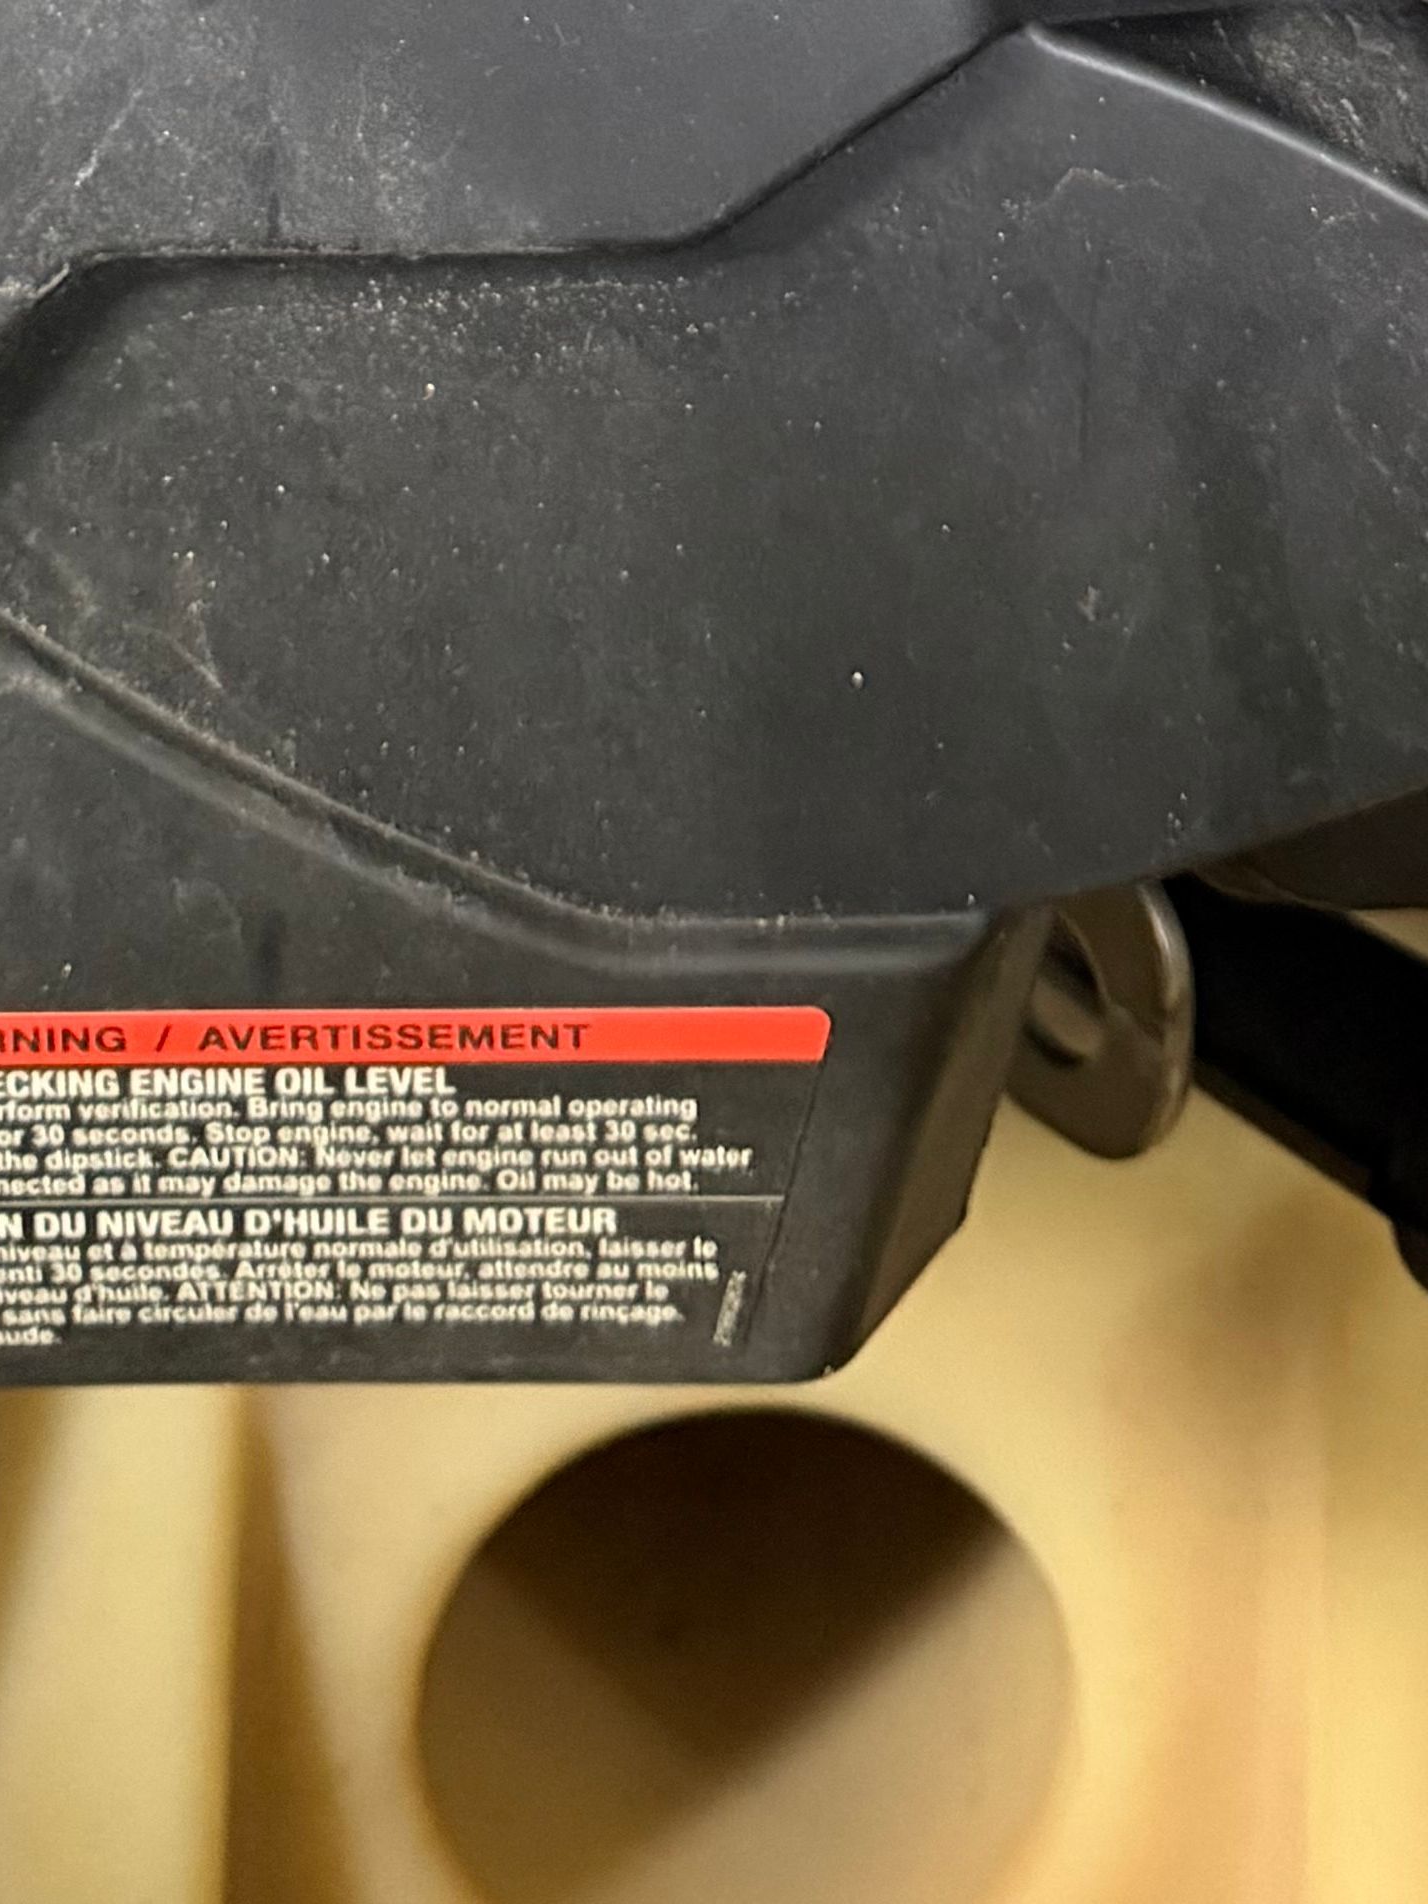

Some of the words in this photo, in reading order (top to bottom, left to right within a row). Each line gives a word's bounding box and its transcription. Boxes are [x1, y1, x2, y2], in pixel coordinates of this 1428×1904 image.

[155, 1024, 172, 1053] /
[197, 1022, 591, 1052] AVERTISSEMENT
[130, 1068, 266, 1096] ENGINE
[274, 1067, 334, 1095] OIL
[344, 1065, 457, 1094] LEVEL
[78, 1096, 240, 1120] verification.
[247, 1096, 323, 1123] Bring
[329, 1096, 423, 1122] engine
[430, 1097, 459, 1117] to
[465, 1094, 561, 1116] normal
[568, 1094, 698, 1123] operating
[31, 1124, 65, 1146] 30
[203, 1121, 272, 1147] Stop
[386, 1121, 443, 1143] wait
[450, 1121, 490, 1142] for
[497, 1122, 524, 1142] at
[530, 1120, 598, 1142] least
[604, 1120, 636, 1142] 30
[44, 1148, 163, 1173] dipstick.
[168, 1146, 308, 1169] CAUTION:
[315, 1146, 396, 1169] Never
[401, 1146, 436, 1167] let
[442, 1145, 534, 1172] engine
[540, 1148, 587, 1167] run
[593, 1146, 638, 1167] out
[644, 1144, 673, 1166] of
[92, 1176, 125, 1194] as
[132, 1173, 152, 1193] it
[157, 1175, 217, 1199] may
[222, 1172, 332, 1197] damage
[338, 1171, 383, 1192] the
[495, 1169, 536, 1191] Oil
[542, 1172, 599, 1196] may
[606, 1171, 640, 1191] be
[647, 1170, 699, 1192] hot.
[33, 1211, 87, 1240] DU
[95, 1210, 234, 1239] NIVEAU
[243, 1208, 391, 1237] D'HUILE
[400, 1208, 453, 1235] DU
[463, 1207, 618, 1235] MOTEUR
[86, 1243, 115, 1262] et
[120, 1242, 138, 1261] à
[143, 1240, 307, 1263] température
[312, 1239, 422, 1259] normale
[598, 1238, 686, 1259] laisser
[693, 1235, 718, 1258] le
[49, 1263, 83, 1283] 30
[234, 1260, 330, 1281] Arrêter
[336, 1259, 363, 1279] le
[477, 1260, 589, 1280] attendre
[596, 1262, 630, 1279] au
[637, 1260, 720, 1281] moins
[349, 1280, 387, 1300] Ne
[392, 1282, 442, 1303] pas
[447, 1280, 536, 1300] laisser
[541, 1280, 639, 1301] tourner
[644, 1280, 670, 1300] le
[2, 1307, 66, 1326] sans
[71, 1303, 132, 1324] faire
[137, 1302, 239, 1324] circuler
[244, 1302, 278, 1323] de
[283, 1301, 348, 1323] l'eau
[353, 1304, 399, 1326] par
[403, 1302, 427, 1321] le
[432, 1301, 536, 1323] raccord
[540, 1302, 574, 1322] de
